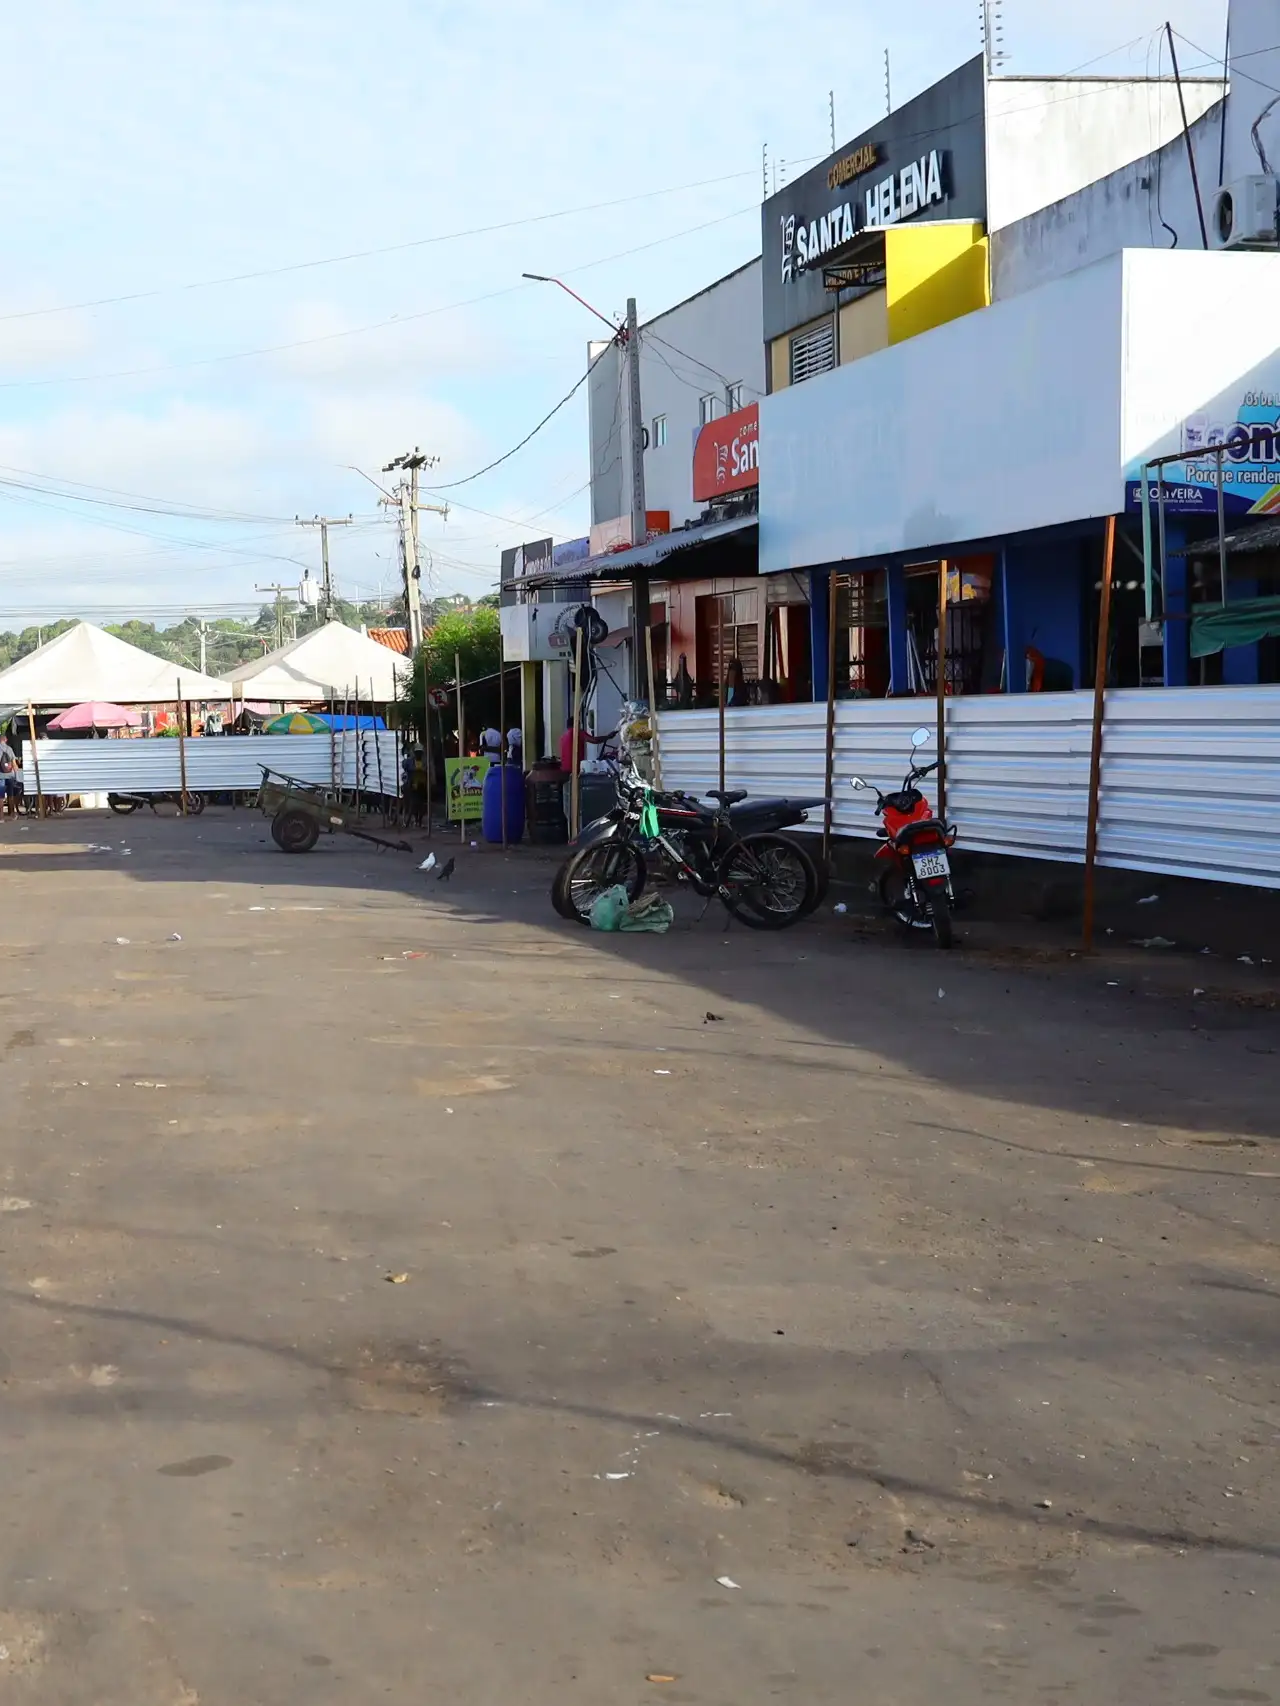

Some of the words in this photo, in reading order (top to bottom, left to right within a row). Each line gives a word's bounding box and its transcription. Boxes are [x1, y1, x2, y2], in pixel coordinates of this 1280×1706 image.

[827, 144, 877, 190] COMERCIAL
[796, 202, 855, 267] SANTA
[865, 149, 942, 226] HELENA
[731, 437, 759, 477] San
[1183, 411, 1280, 464] Econ
[1149, 488, 1203, 499] OIVEIRA
[921, 856, 940, 868] SMZ
